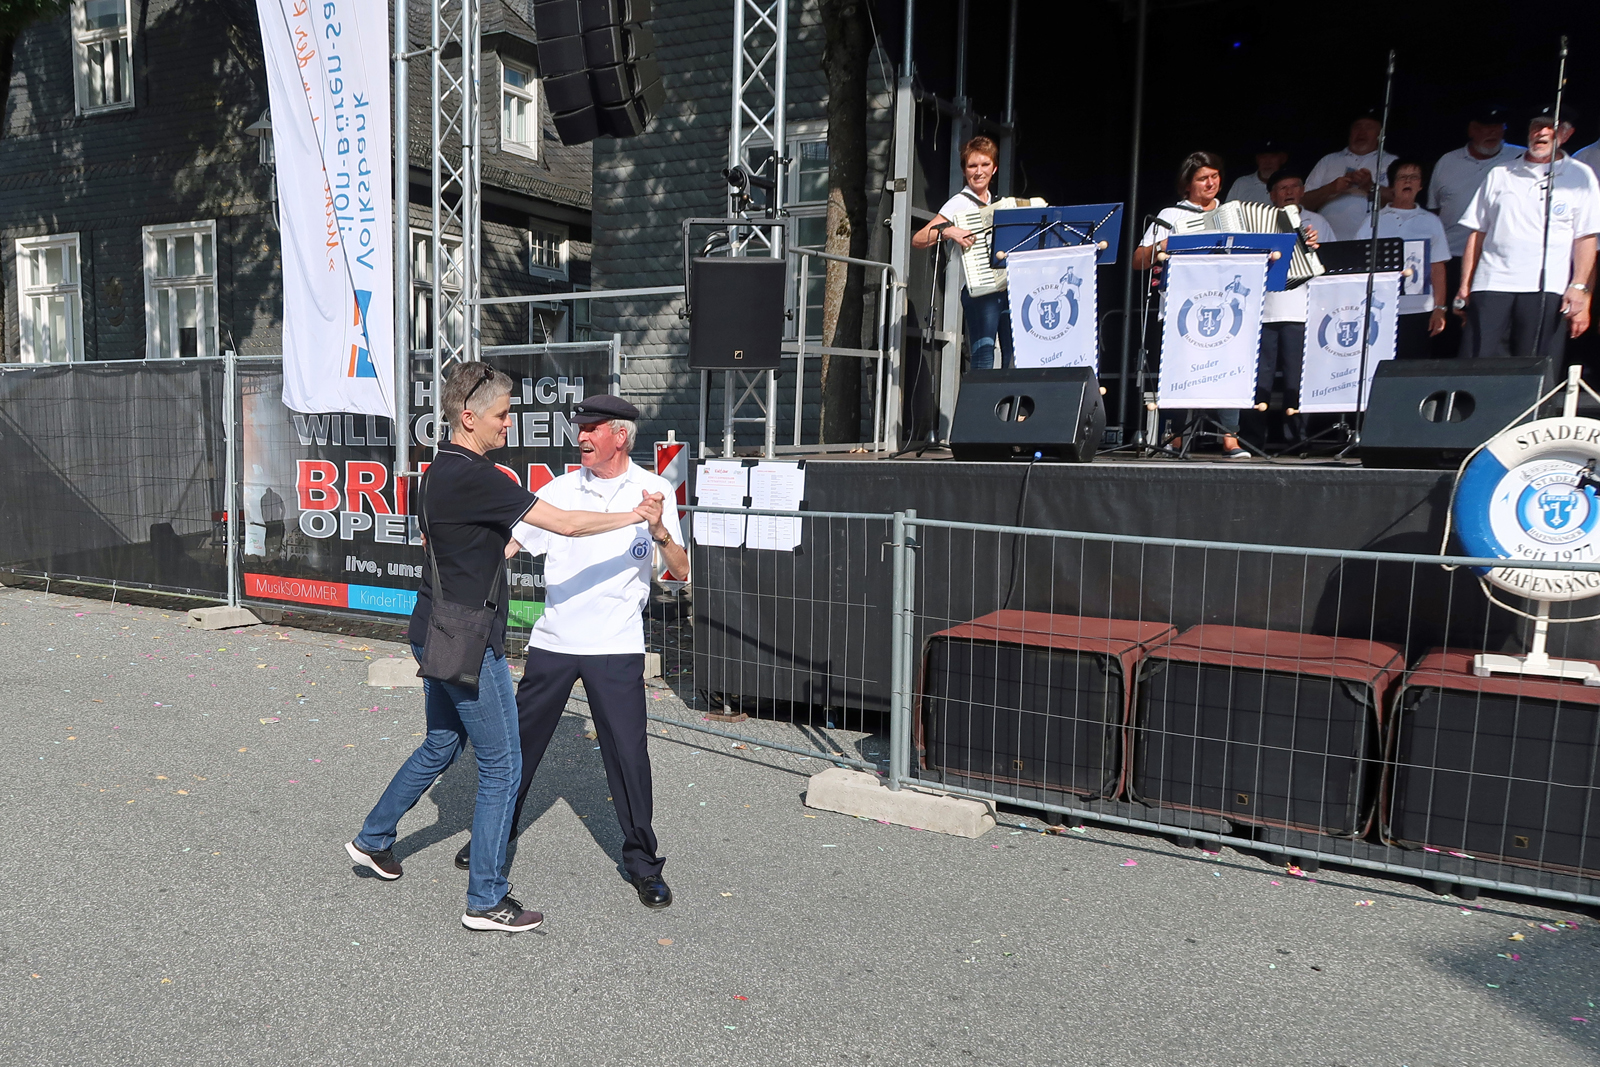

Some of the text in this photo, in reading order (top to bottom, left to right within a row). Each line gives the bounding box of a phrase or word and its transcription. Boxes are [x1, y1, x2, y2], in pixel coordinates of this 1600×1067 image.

[1032, 283, 1060, 296] STADER
[1193, 290, 1224, 301] STADER
[1331, 305, 1360, 316] STADER
[1039, 350, 1064, 366] Stader
[1073, 353, 1087, 366] e.V.
[1190, 359, 1220, 373] Stader
[1170, 365, 1246, 392] Hafensänger e.V.
[1330, 367, 1358, 381] Stader
[1311, 379, 1360, 398] Hafensäng
[1515, 424, 1600, 450] STADER
[1535, 475, 1577, 488] STADER
[1514, 542, 1594, 563] seit 1977
[345, 555, 423, 578] live, ums
[255, 578, 338, 602] MusikSOMMER
